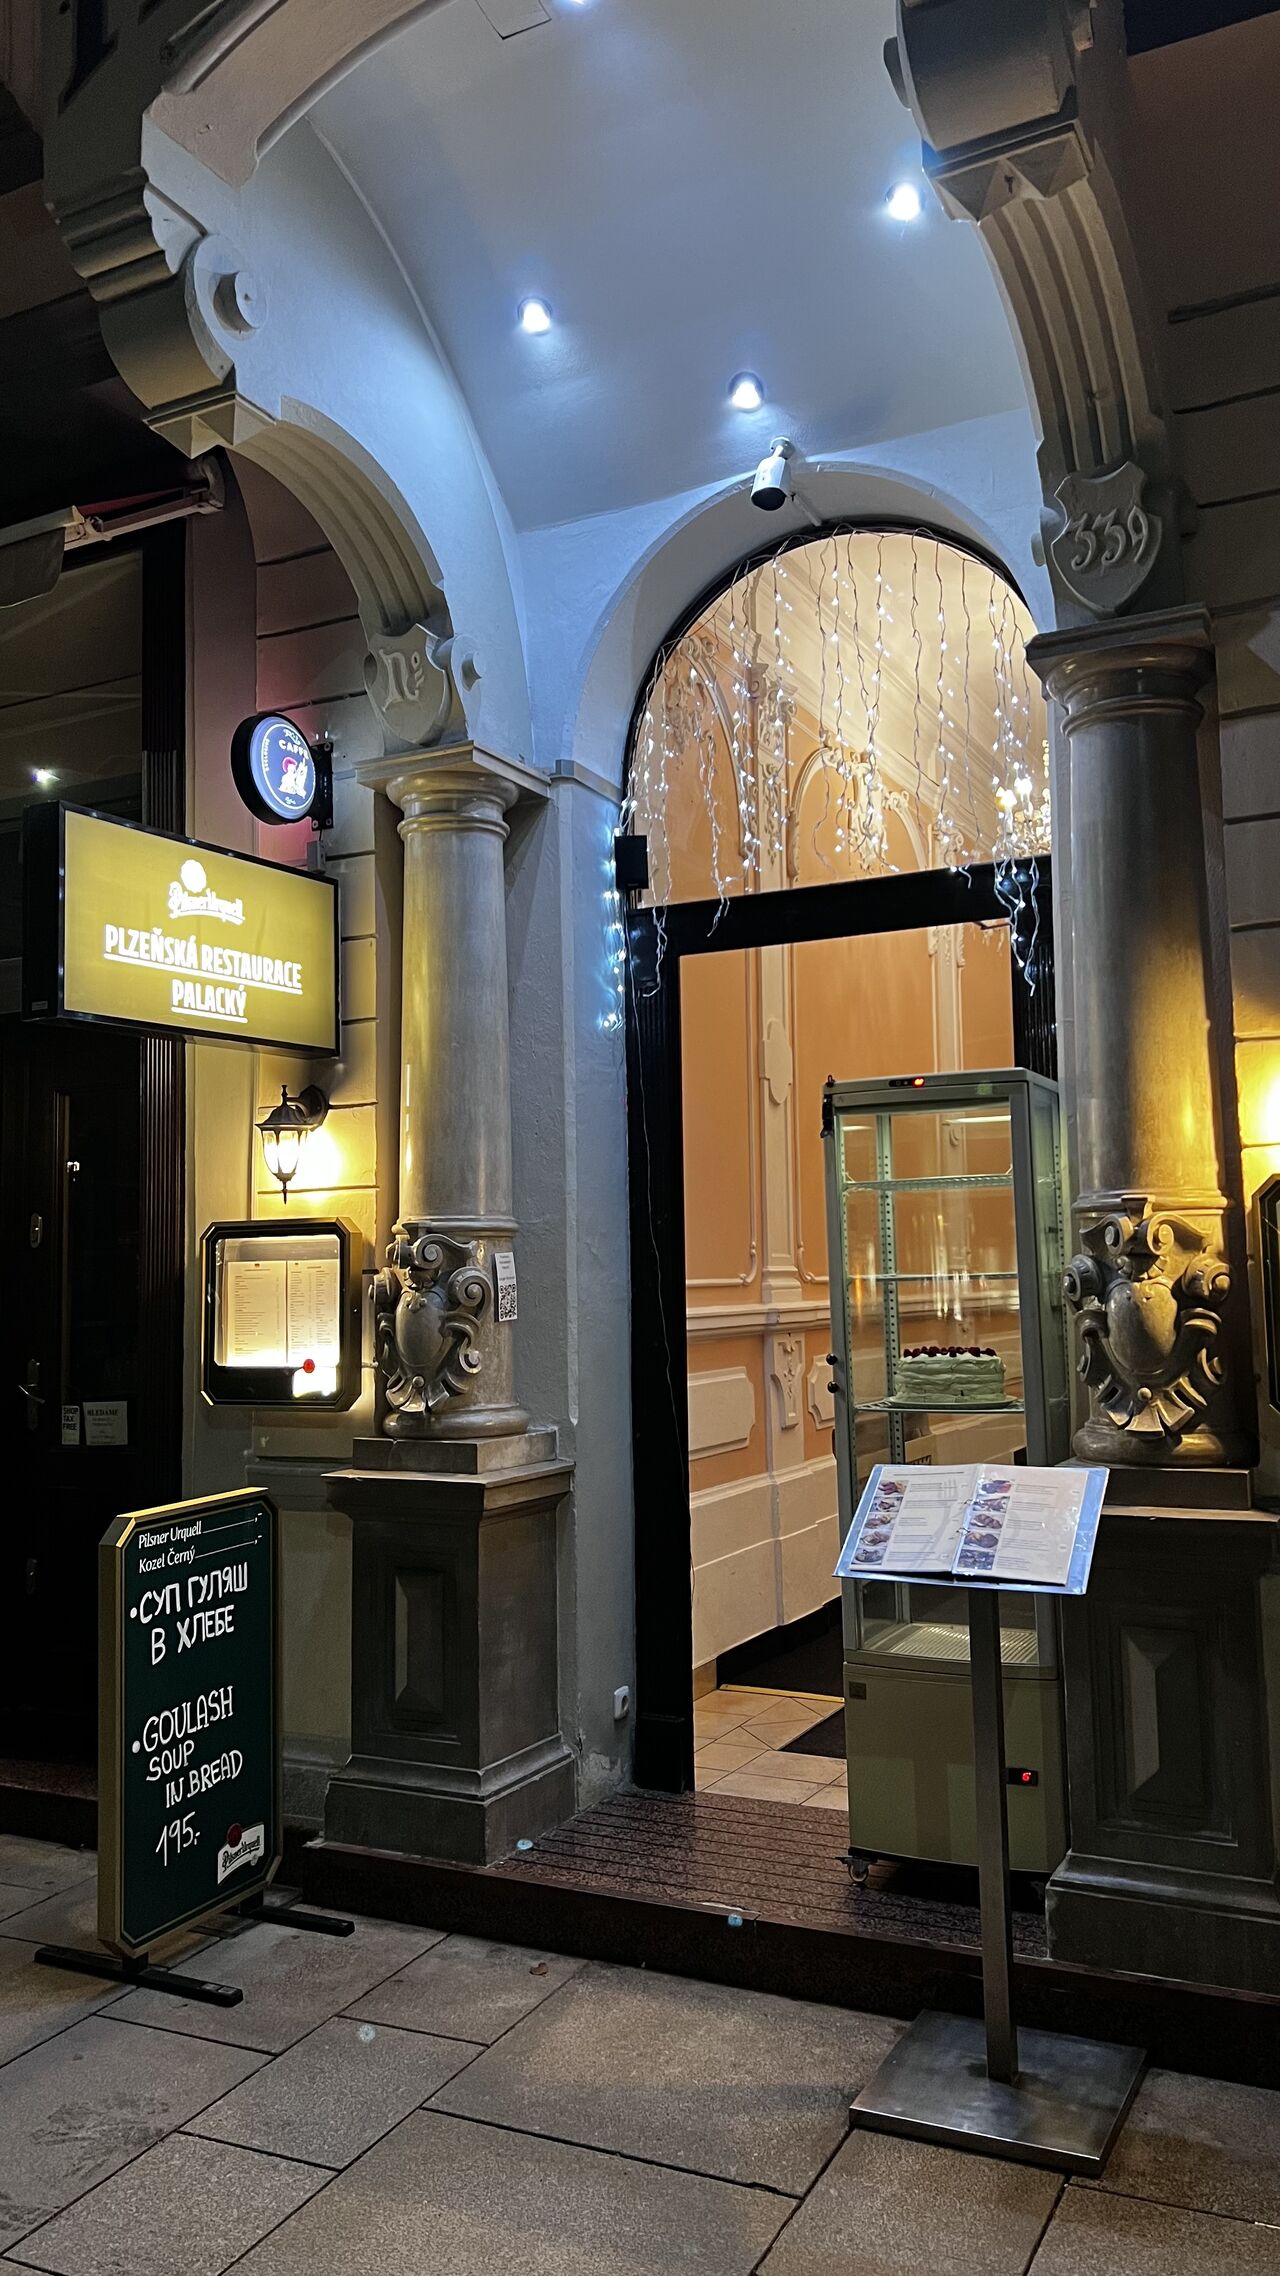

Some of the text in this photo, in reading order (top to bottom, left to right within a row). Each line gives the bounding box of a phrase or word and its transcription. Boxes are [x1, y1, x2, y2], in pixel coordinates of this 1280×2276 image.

[104, 923, 303, 989] PLZEŇSKÁ RESTAURACE
[171, 979, 247, 1017] PALACKÝ
[63, 1423, 78, 1431] FREE
[138, 1530, 170, 1549] Pilsner
[170, 1520, 202, 1542] Urquell
[138, 1552, 166, 1574] Kozel
[167, 1545, 196, 1565] Černý
[139, 1561, 248, 1625] СУП ГУЛЯШ
[176, 1604, 235, 1654] ХЛЕБЕ
[142, 1685, 234, 1752] GOULASH
[145, 1739, 195, 1782] SOUP
[165, 1749, 243, 1809] IN BREAD
